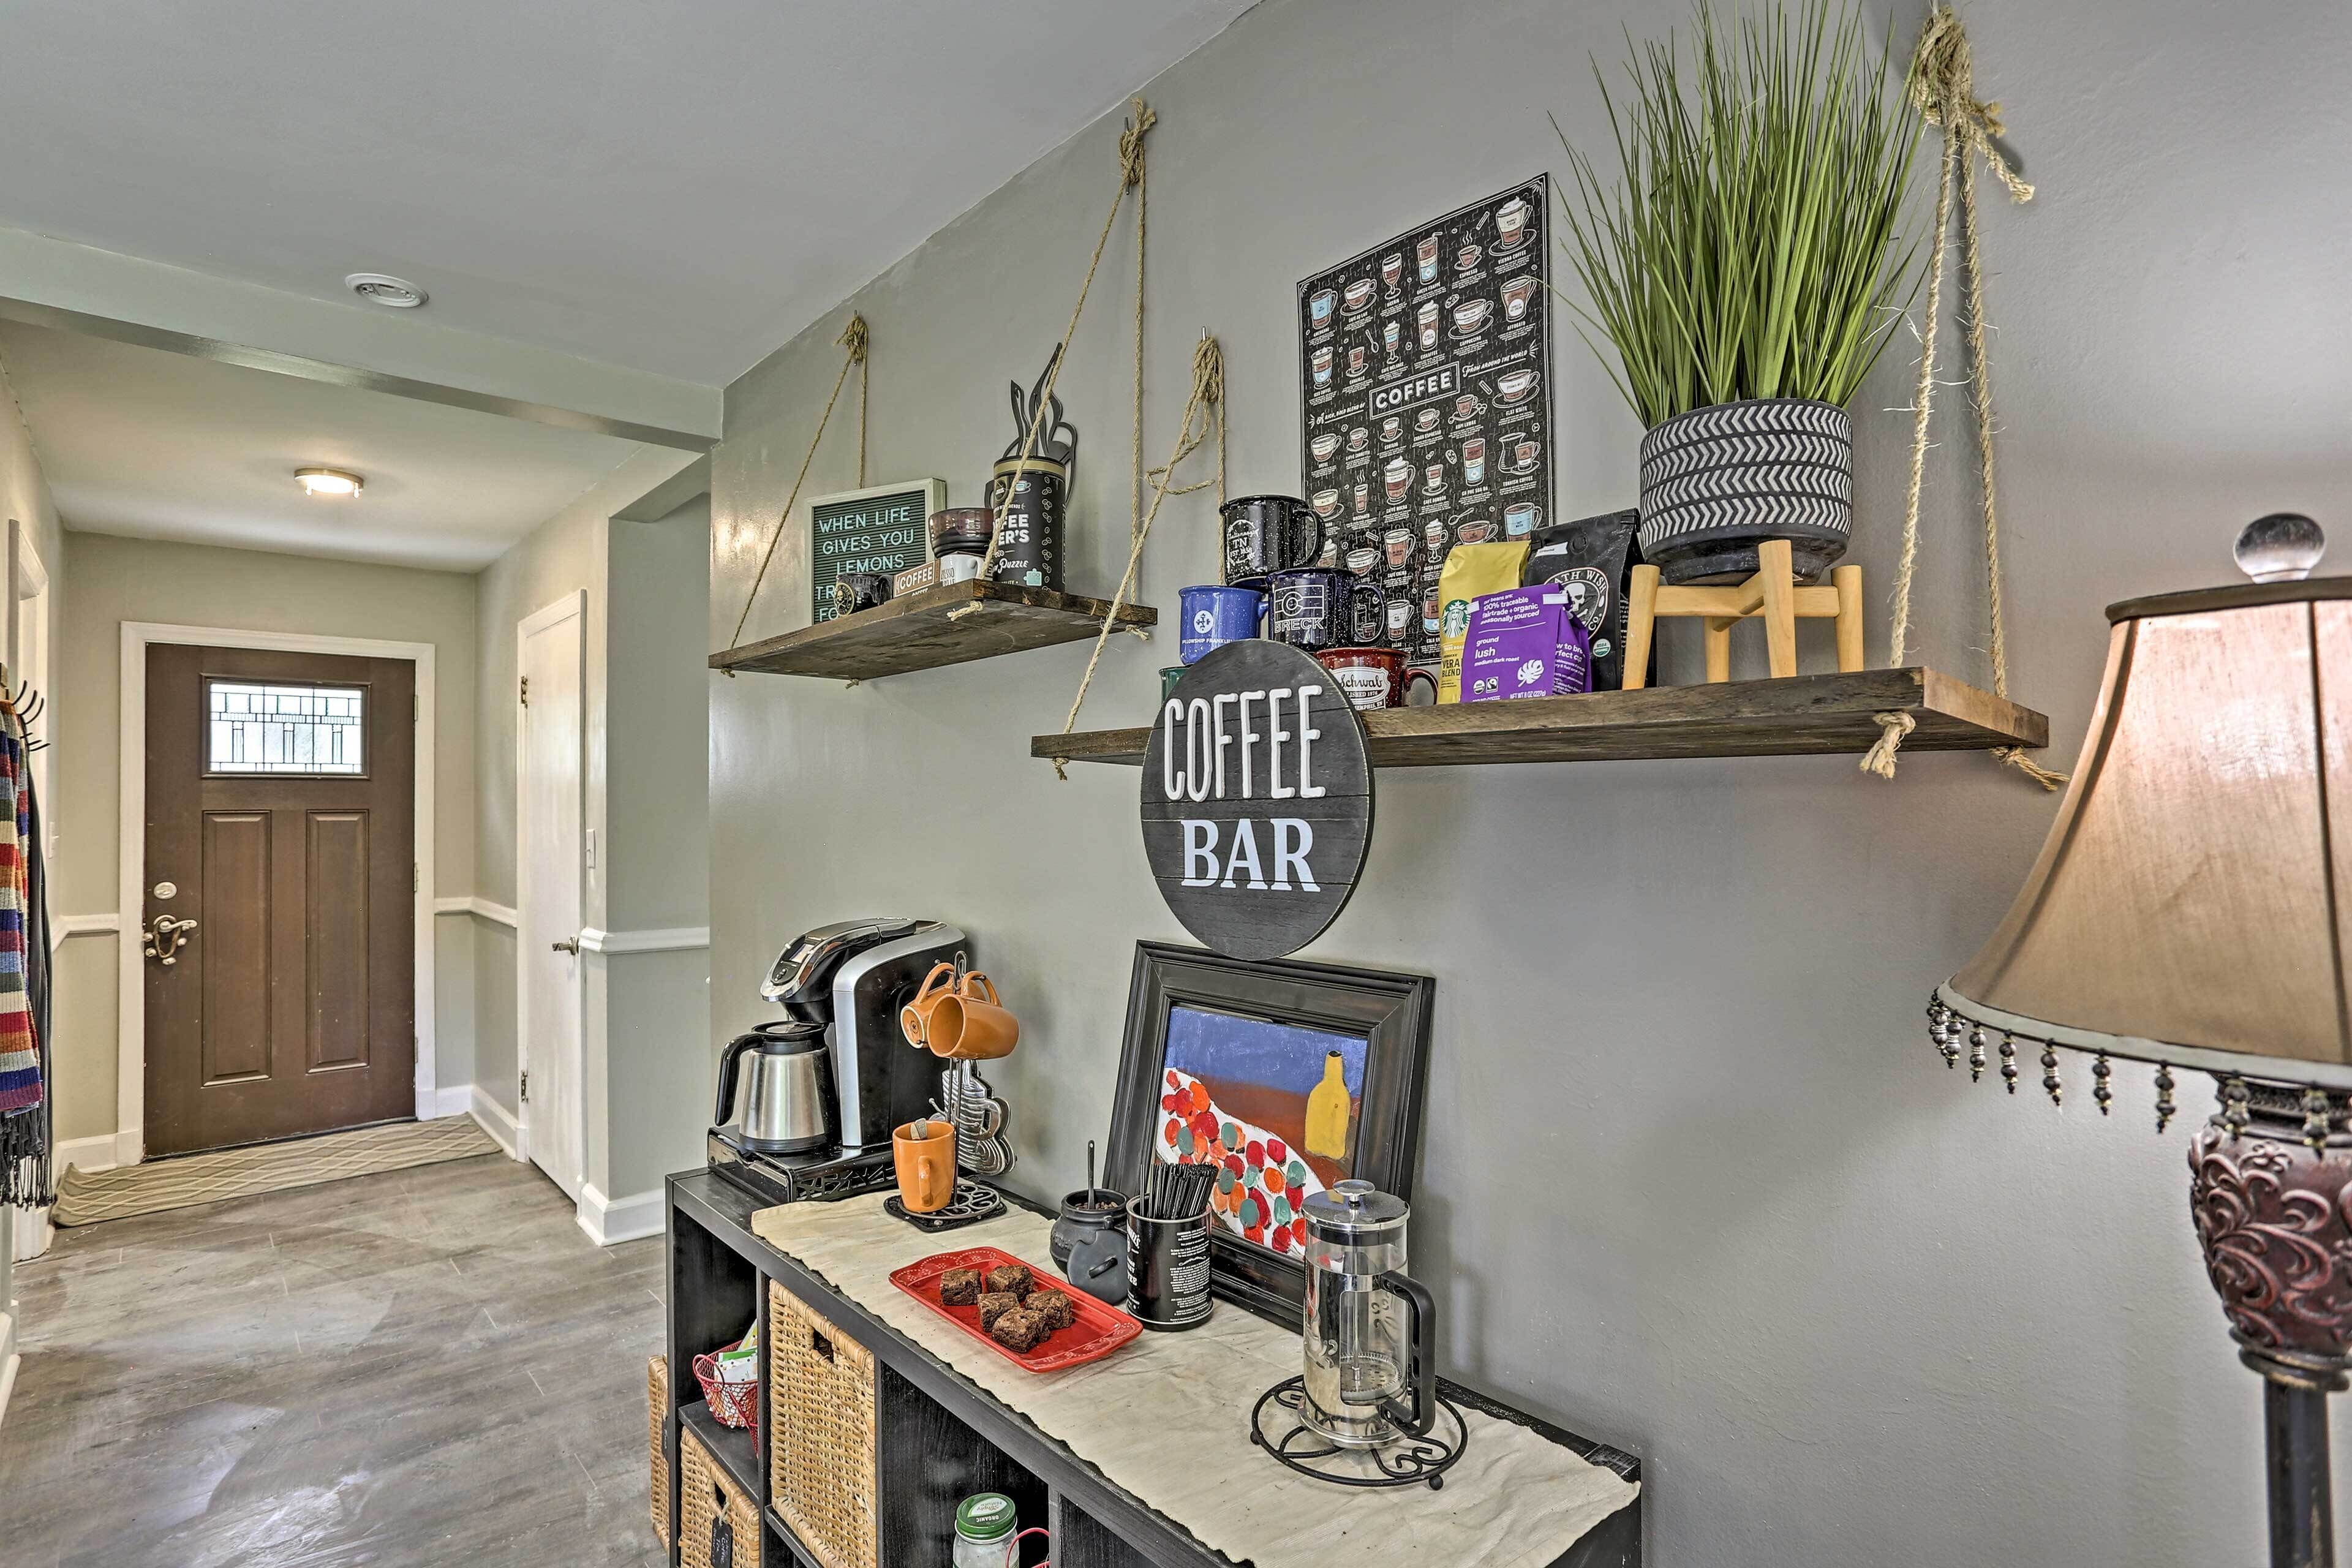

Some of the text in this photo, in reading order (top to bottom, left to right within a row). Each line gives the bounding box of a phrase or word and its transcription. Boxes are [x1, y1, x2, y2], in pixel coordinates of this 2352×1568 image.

[1512, 249, 1526, 259] COFFEE
[1459, 267, 1477, 279] ESPRESSO
[1507, 320, 1525, 331] AFFOGATO
[1460, 334, 1481, 347] CAPPUCCINO
[1480, 358, 1501, 369] AROUND
[1510, 349, 1528, 360] WORLD
[1376, 370, 1452, 411] COFFEE
[1346, 404, 1359, 413] BLEND
[1425, 429, 1441, 439] ESPRESSO
[1502, 475, 1532, 487] TURKISH COFFEE
[819, 507, 910, 533] WHEN LIFE
[823, 529, 914, 554] GIVES YOU
[998, 529, 1030, 546] ER'S
[1232, 537, 1247, 549] TN
[837, 554, 905, 575] LEMONS
[900, 567, 933, 590] COFFEE
[816, 586, 835, 600] TR
[1501, 597, 1529, 608] traceable
[1555, 570, 1607, 631] ATH WISH CO.
[819, 607, 839, 622] FO
[1480, 610, 1540, 625] seasonally sourced
[1482, 608, 1508, 619] fairtrade
[1513, 603, 1539, 612] organic
[1275, 618, 1324, 633] BRECK
[1476, 636, 1499, 647] ground
[1475, 647, 1496, 659] lush
[1555, 649, 1573, 659] rfect
[1442, 658, 1463, 669] VERA
[1442, 668, 1460, 677] BLEND
[1340, 674, 1383, 687] Schwab
[1164, 684, 1326, 802] COFFEE
[1180, 818, 1321, 892] BAR
